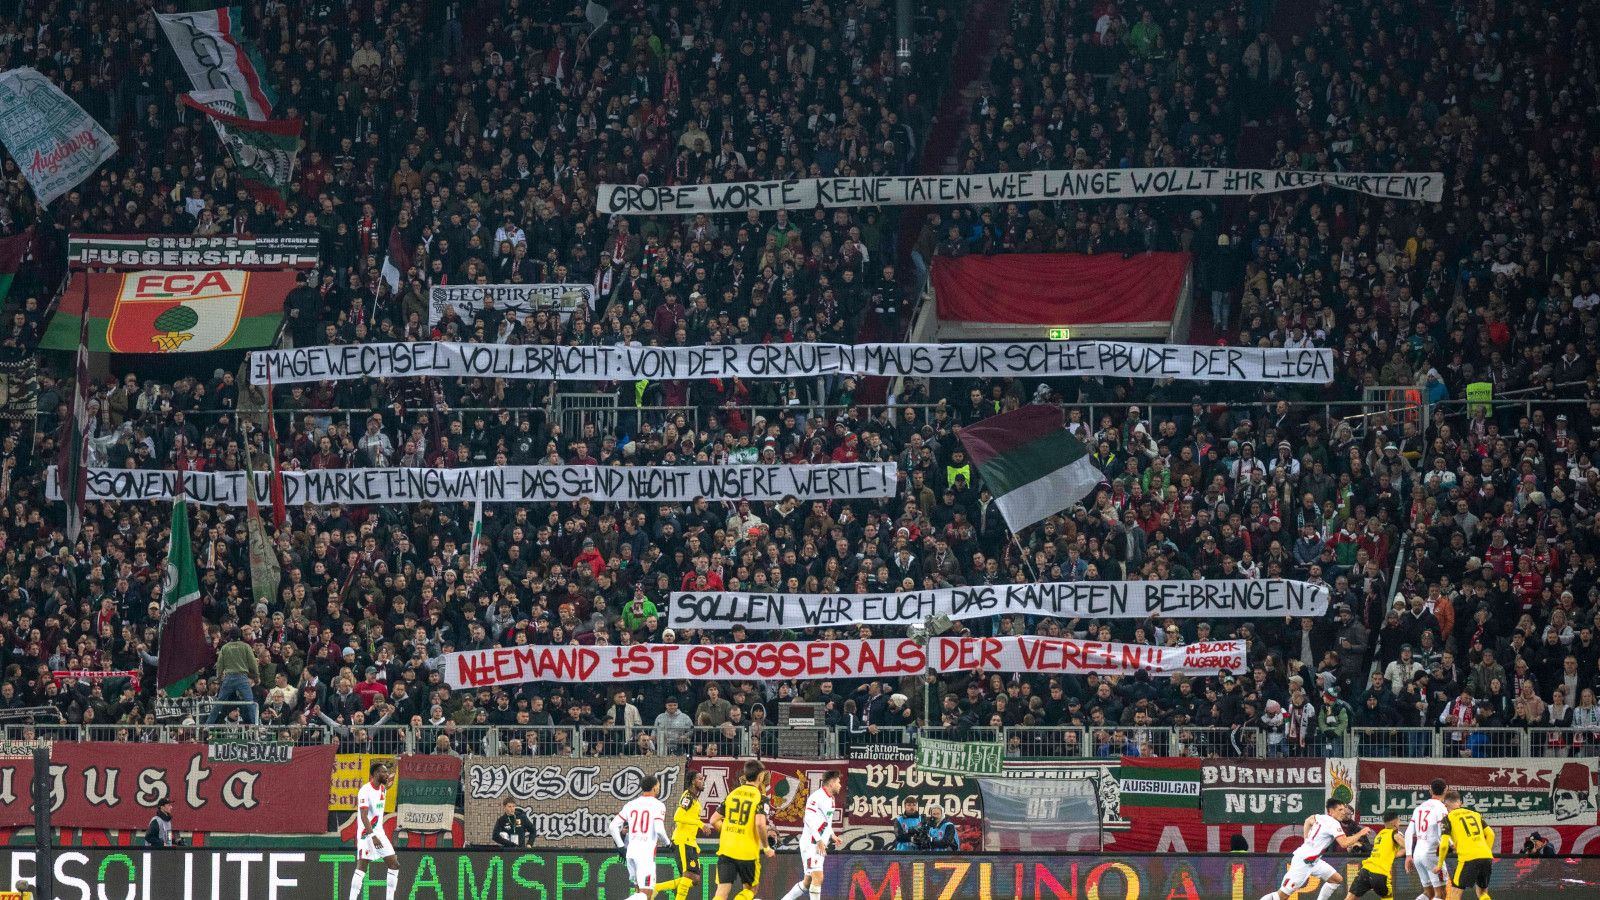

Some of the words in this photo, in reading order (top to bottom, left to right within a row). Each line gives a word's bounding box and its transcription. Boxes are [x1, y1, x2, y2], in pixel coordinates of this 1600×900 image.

[29, 129, 99, 177] Augsburg
[707, 180, 802, 208] WORTE
[816, 177, 890, 204] KEINE
[1043, 172, 1122, 197] LANGE
[1133, 169, 1220, 193] WOLLT
[147, 237, 239, 249] GRUPPE
[135, 271, 233, 296] FCA
[627, 347, 677, 377] VON
[688, 347, 739, 376] DER
[748, 344, 856, 375] GRAUEN
[865, 345, 931, 375] MAUS
[938, 346, 999, 374] ZUR
[1192, 350, 1246, 380] DER
[699, 467, 781, 498] UNSERE
[675, 593, 785, 625] SOLLEN
[863, 592, 936, 621] EUCH
[951, 587, 998, 615] DAS
[686, 641, 849, 678] GRÖSSER
[858, 640, 927, 673] ALS
[940, 638, 1003, 671] DER
[1183, 655, 1242, 670] AUGSBURG
[214, 741, 290, 762] LUSTENAU
[921, 748, 967, 771] TETE!
[1122, 779, 1197, 795] AUGSBULGAR
[1202, 765, 1322, 785] BURNING
[728, 797, 753, 826] 28
[1225, 793, 1303, 813] NUTS
[630, 809, 650, 834] 20
[1418, 809, 1431, 833] 13
[1459, 815, 1482, 837] 13
